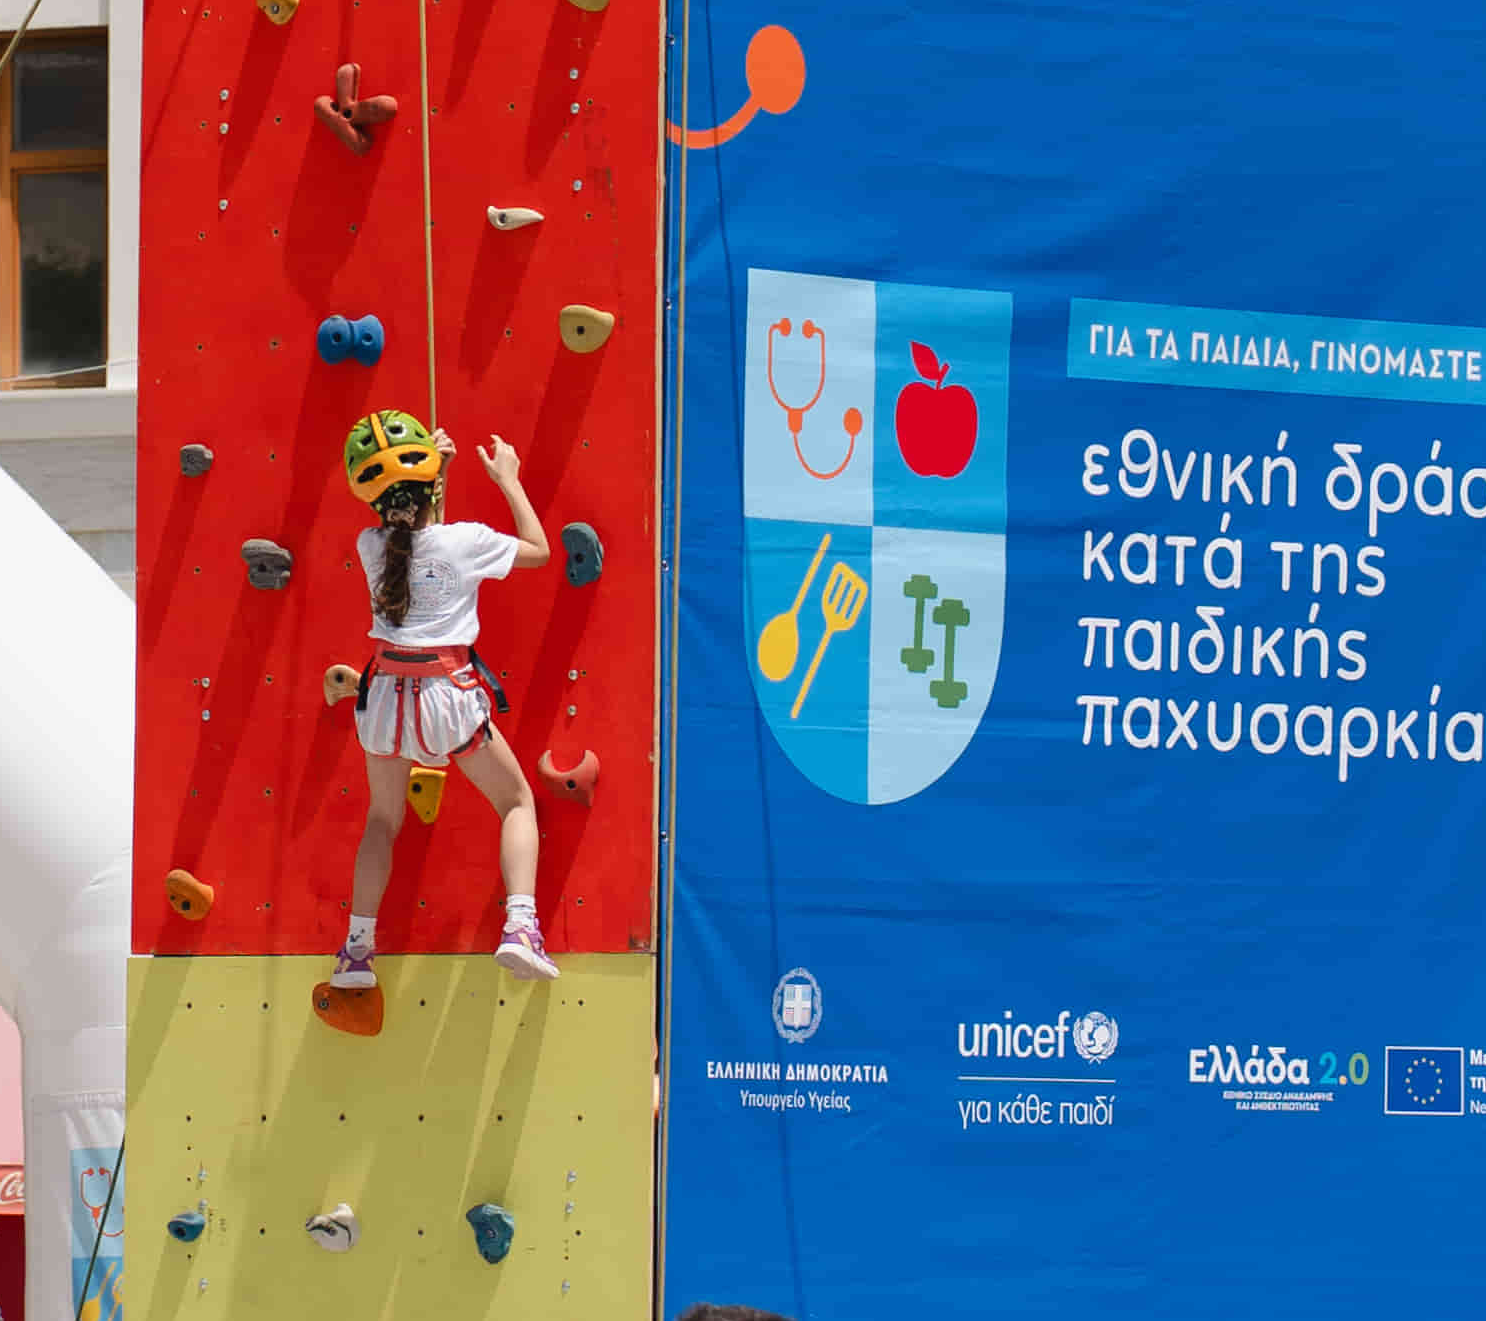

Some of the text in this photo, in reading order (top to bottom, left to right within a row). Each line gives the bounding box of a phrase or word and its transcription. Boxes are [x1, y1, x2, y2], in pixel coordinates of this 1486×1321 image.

[1091, 324, 1134, 357] ΓΙΑ
[1146, 328, 1179, 361] ΤΑ
[1191, 332, 1300, 373] ΠΑΙΔΙΑ,
[1310, 341, 1482, 381] ΓΙΝΟΜΑΣΤΕ
[1082, 428, 1297, 508] εθνική
[1082, 514, 1386, 597] κατά της
[1078, 604, 1367, 681] παιδικής
[958, 1010, 1071, 1059] unicef
[707, 1061, 888, 1083] ΕΛΛΗΝΙΚΗ ΔΗΜΟΚΡΑΤΙΑ
[1189, 1044, 1370, 1086] Ελλάδα 2.0
[740, 1089, 851, 1112] Υπουργείο Υγείας
[958, 1094, 1114, 1130] για κάθε παιδί
